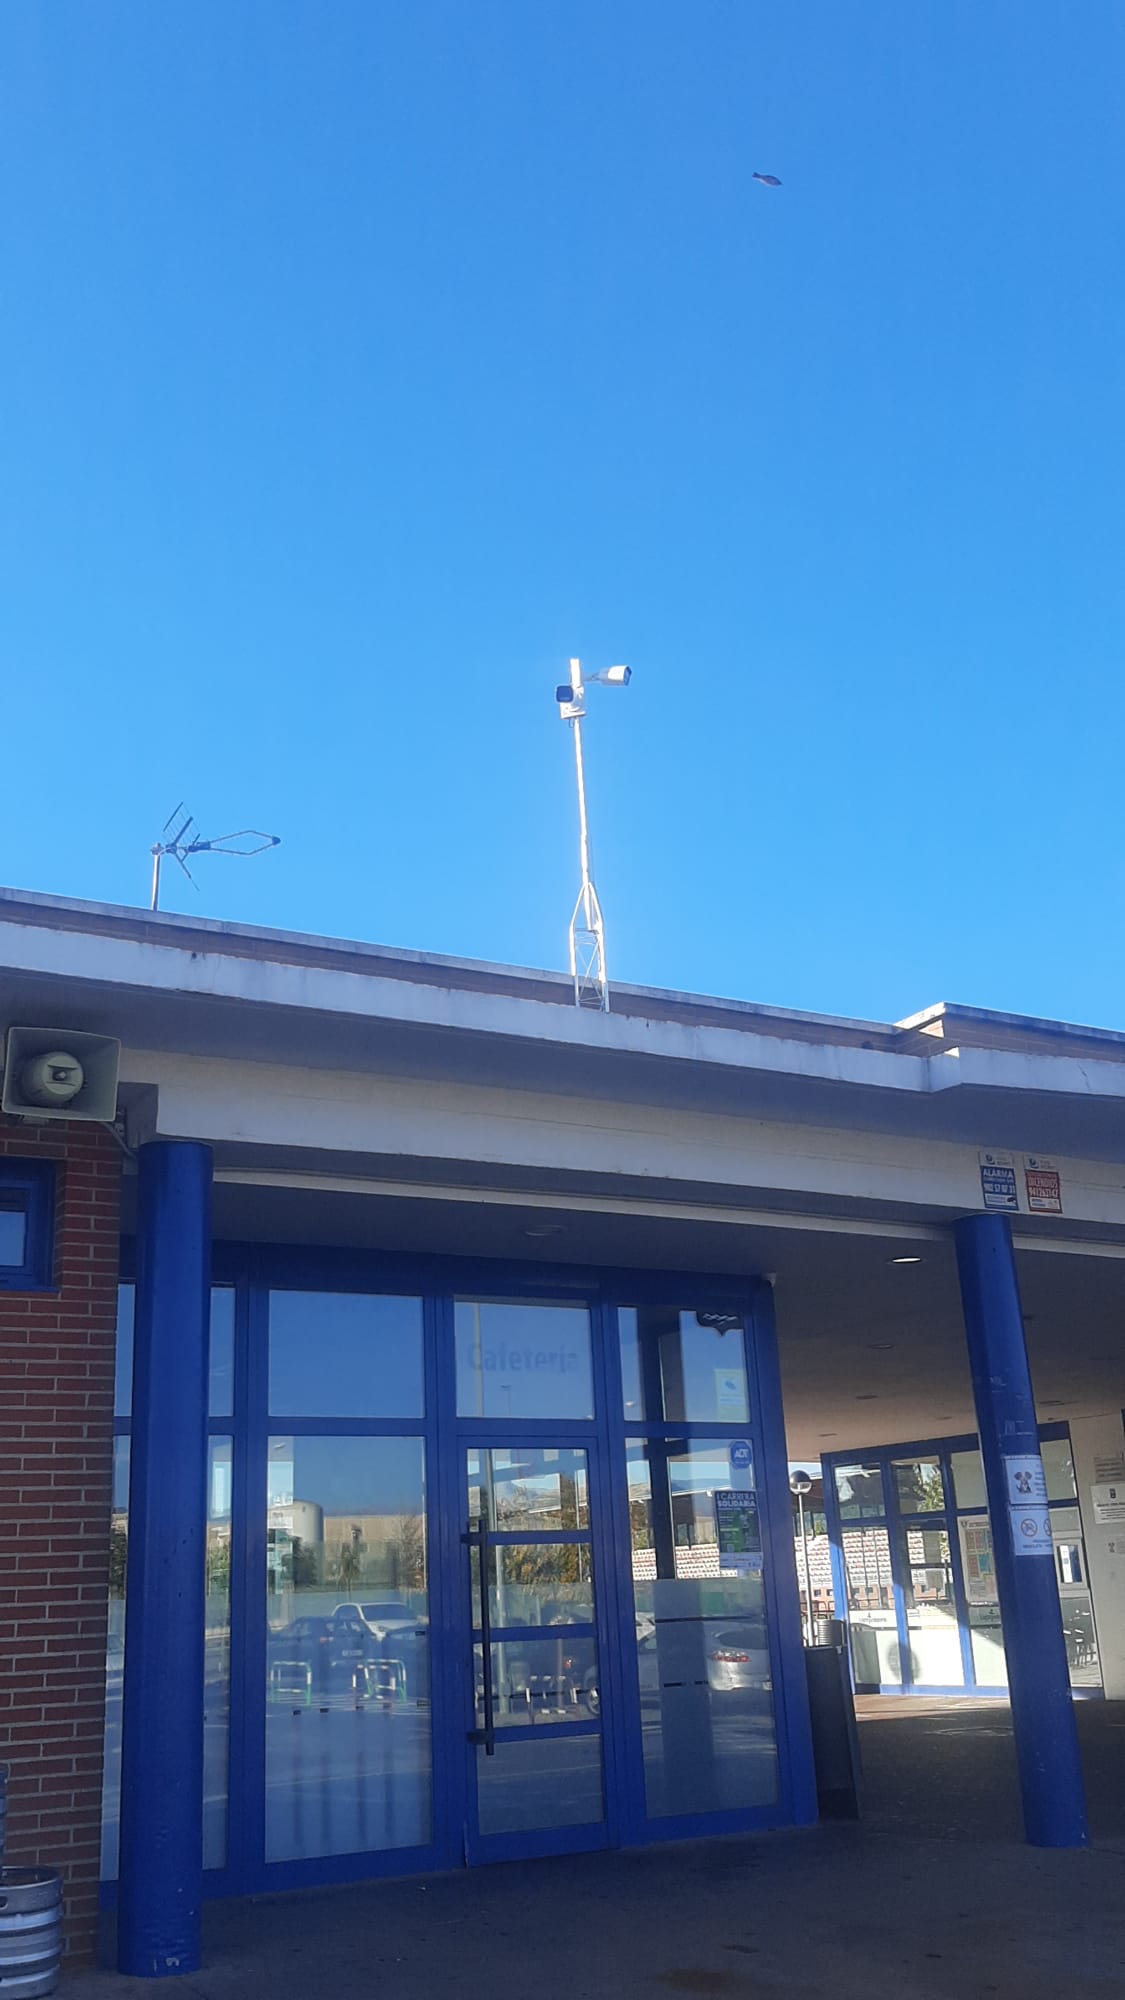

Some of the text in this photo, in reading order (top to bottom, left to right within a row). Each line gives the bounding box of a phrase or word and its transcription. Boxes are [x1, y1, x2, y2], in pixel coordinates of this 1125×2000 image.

[983, 1168, 1014, 1178] ALARMA
[734, 1448, 749, 1459] ADT
[721, 1493, 755, 1502] CARRERA
[717, 1500, 756, 1508] SOLIDARIA
